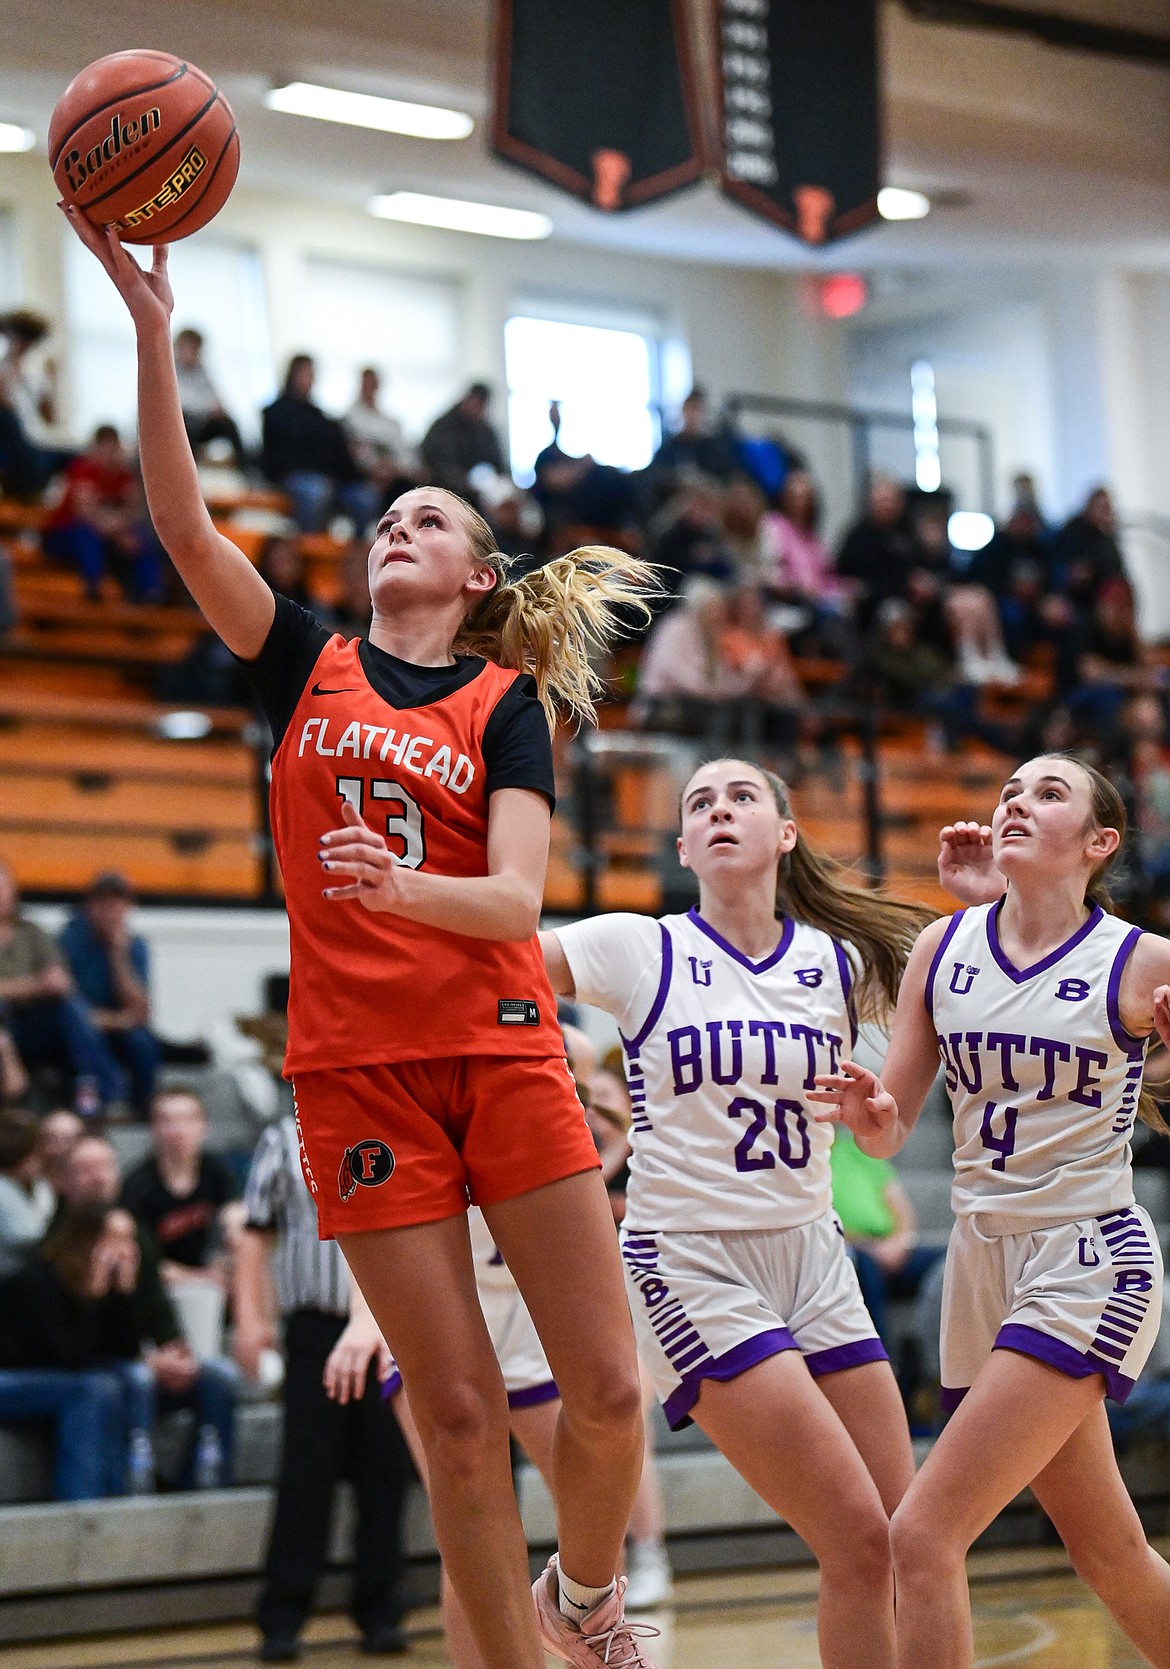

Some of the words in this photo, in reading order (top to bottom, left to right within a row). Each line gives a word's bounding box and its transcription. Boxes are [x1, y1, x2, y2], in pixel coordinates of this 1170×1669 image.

[64, 107, 160, 194] Baden
[172, 151, 204, 193] PRO
[298, 718, 475, 794] FLATHEAD
[794, 968, 823, 989] B
[1055, 978, 1091, 1001] B
[529, 1007, 537, 1018] M
[727, 1096, 811, 1172] 20
[980, 1101, 1018, 1171] 4
[358, 1147, 381, 1180] F
[1113, 1269, 1152, 1292] B
